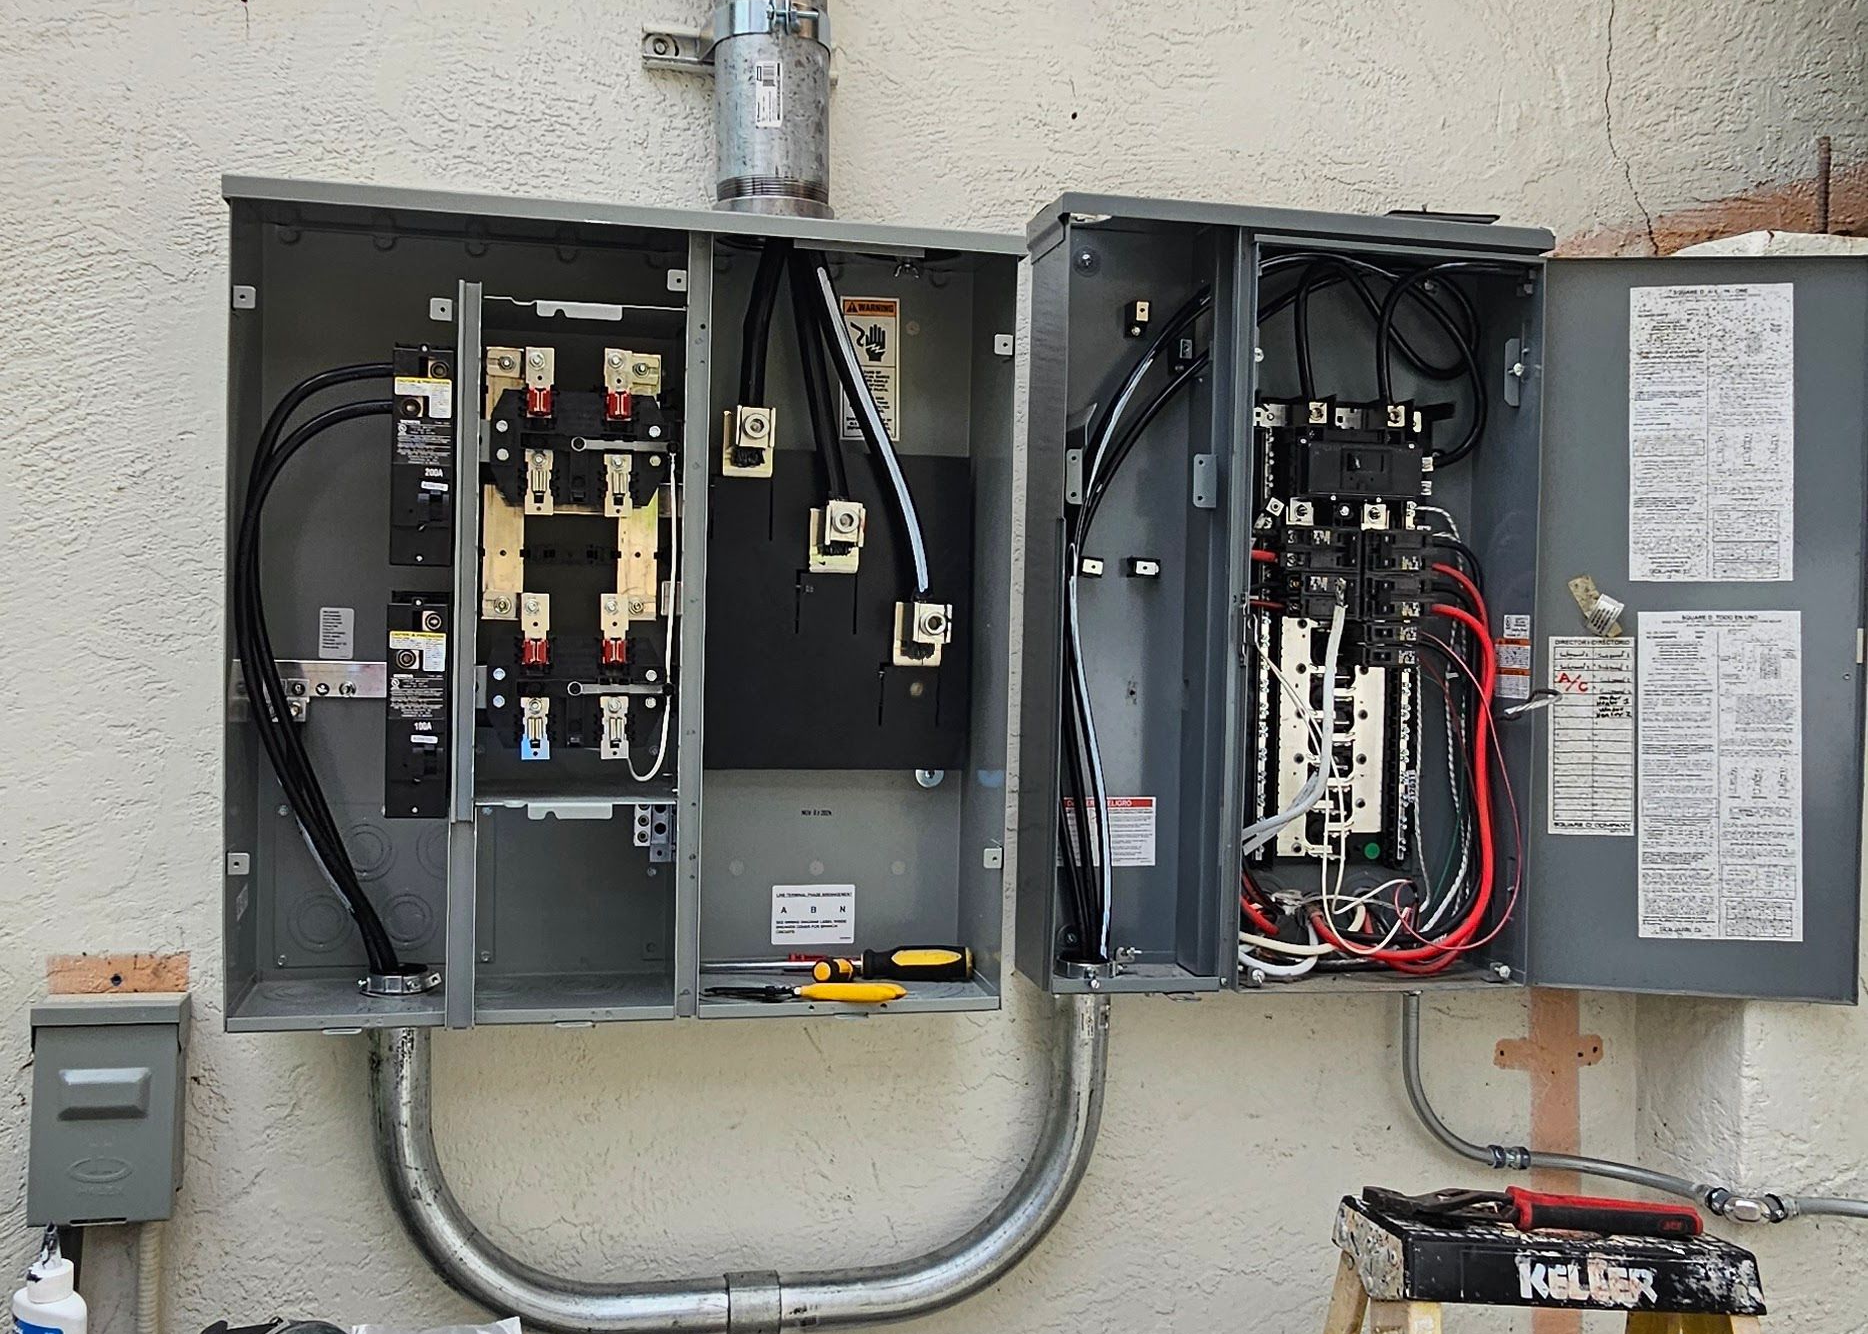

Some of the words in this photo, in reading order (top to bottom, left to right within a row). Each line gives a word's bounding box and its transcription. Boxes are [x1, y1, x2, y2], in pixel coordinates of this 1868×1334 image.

[425, 468, 443, 478] 200A
[1559, 672, 1588, 692] A/C
[1515, 1253, 1658, 1307] KELLER
